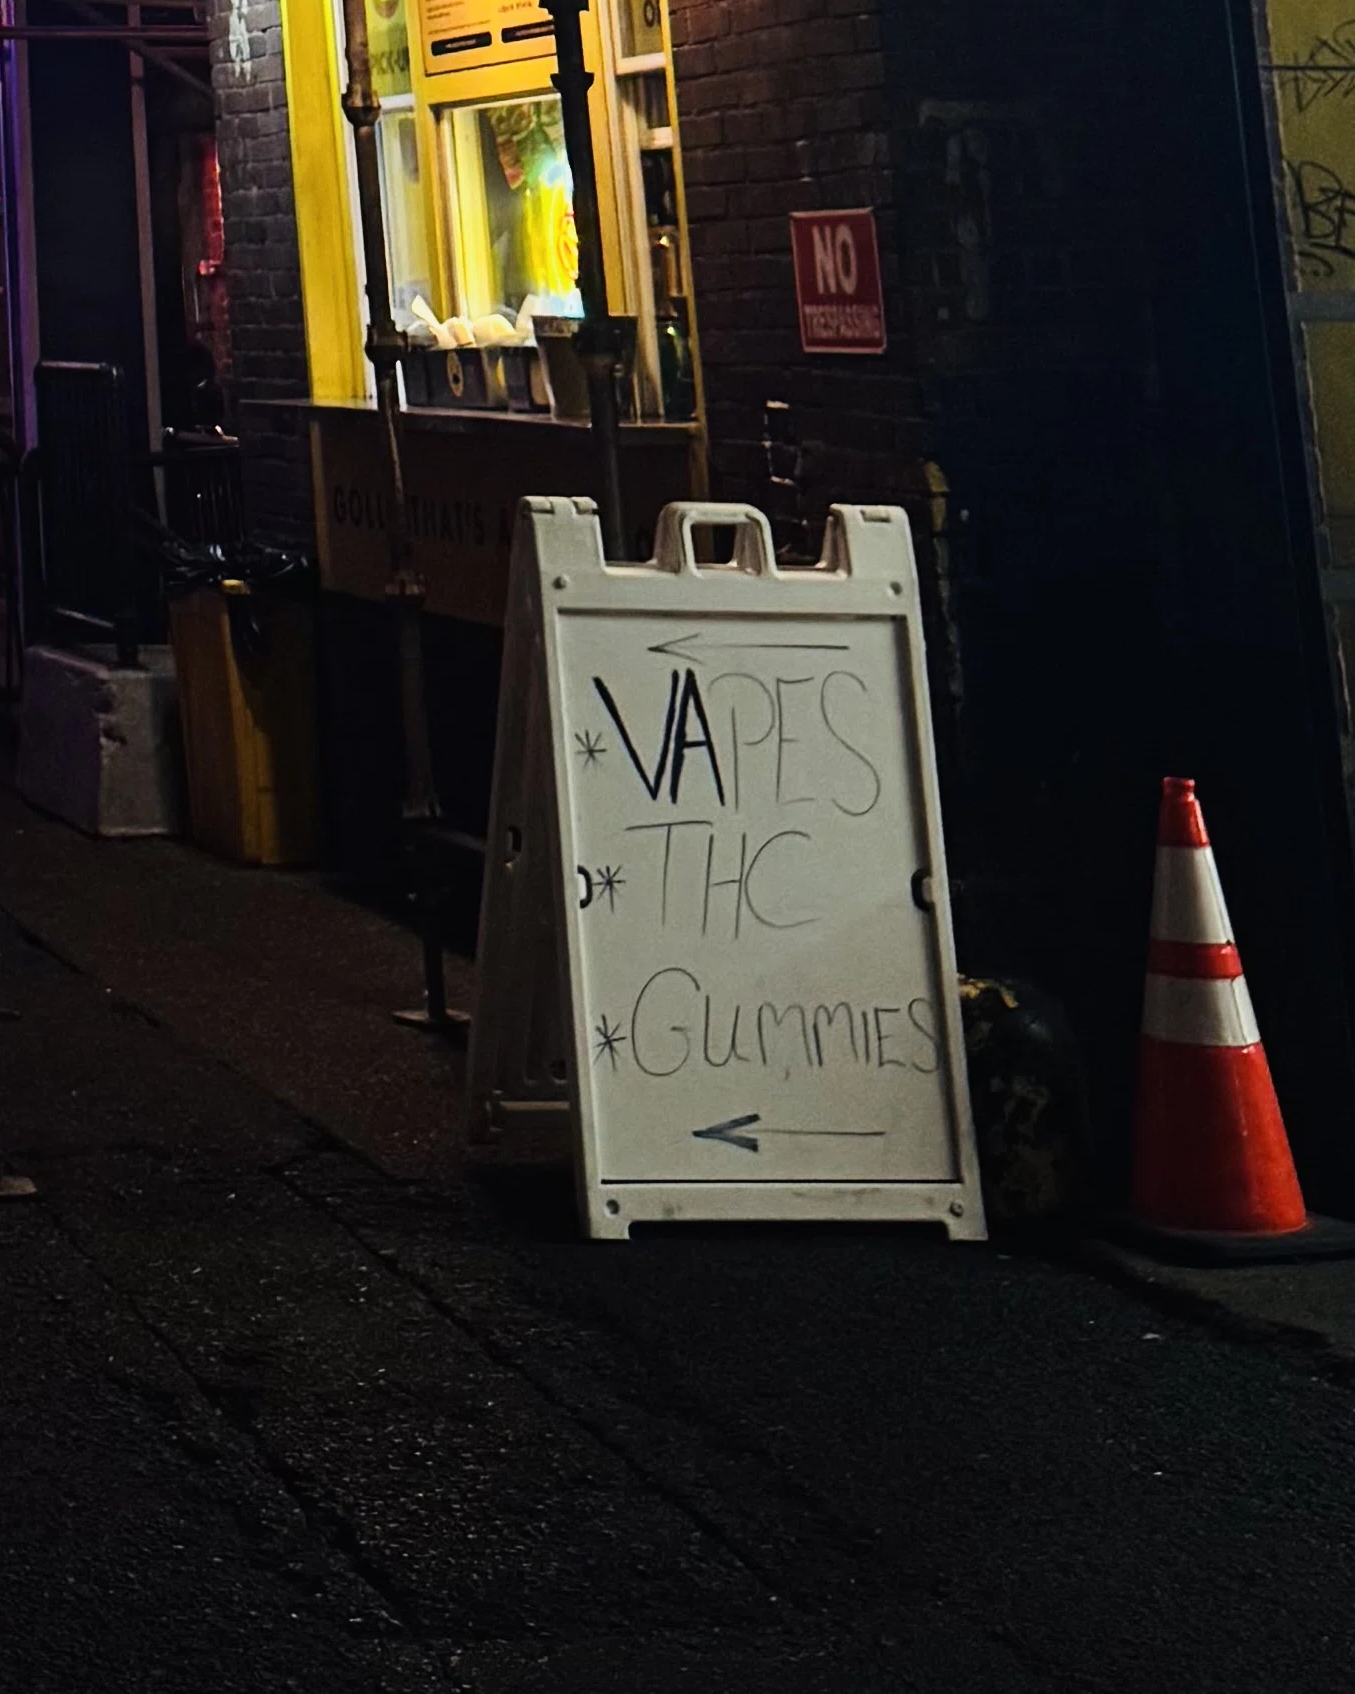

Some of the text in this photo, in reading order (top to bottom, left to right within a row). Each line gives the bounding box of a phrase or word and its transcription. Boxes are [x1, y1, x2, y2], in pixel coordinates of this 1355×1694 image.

[811, 223, 859, 296] NO
[592, 668, 882, 816] VAPES
[624, 820, 822, 941] THC
